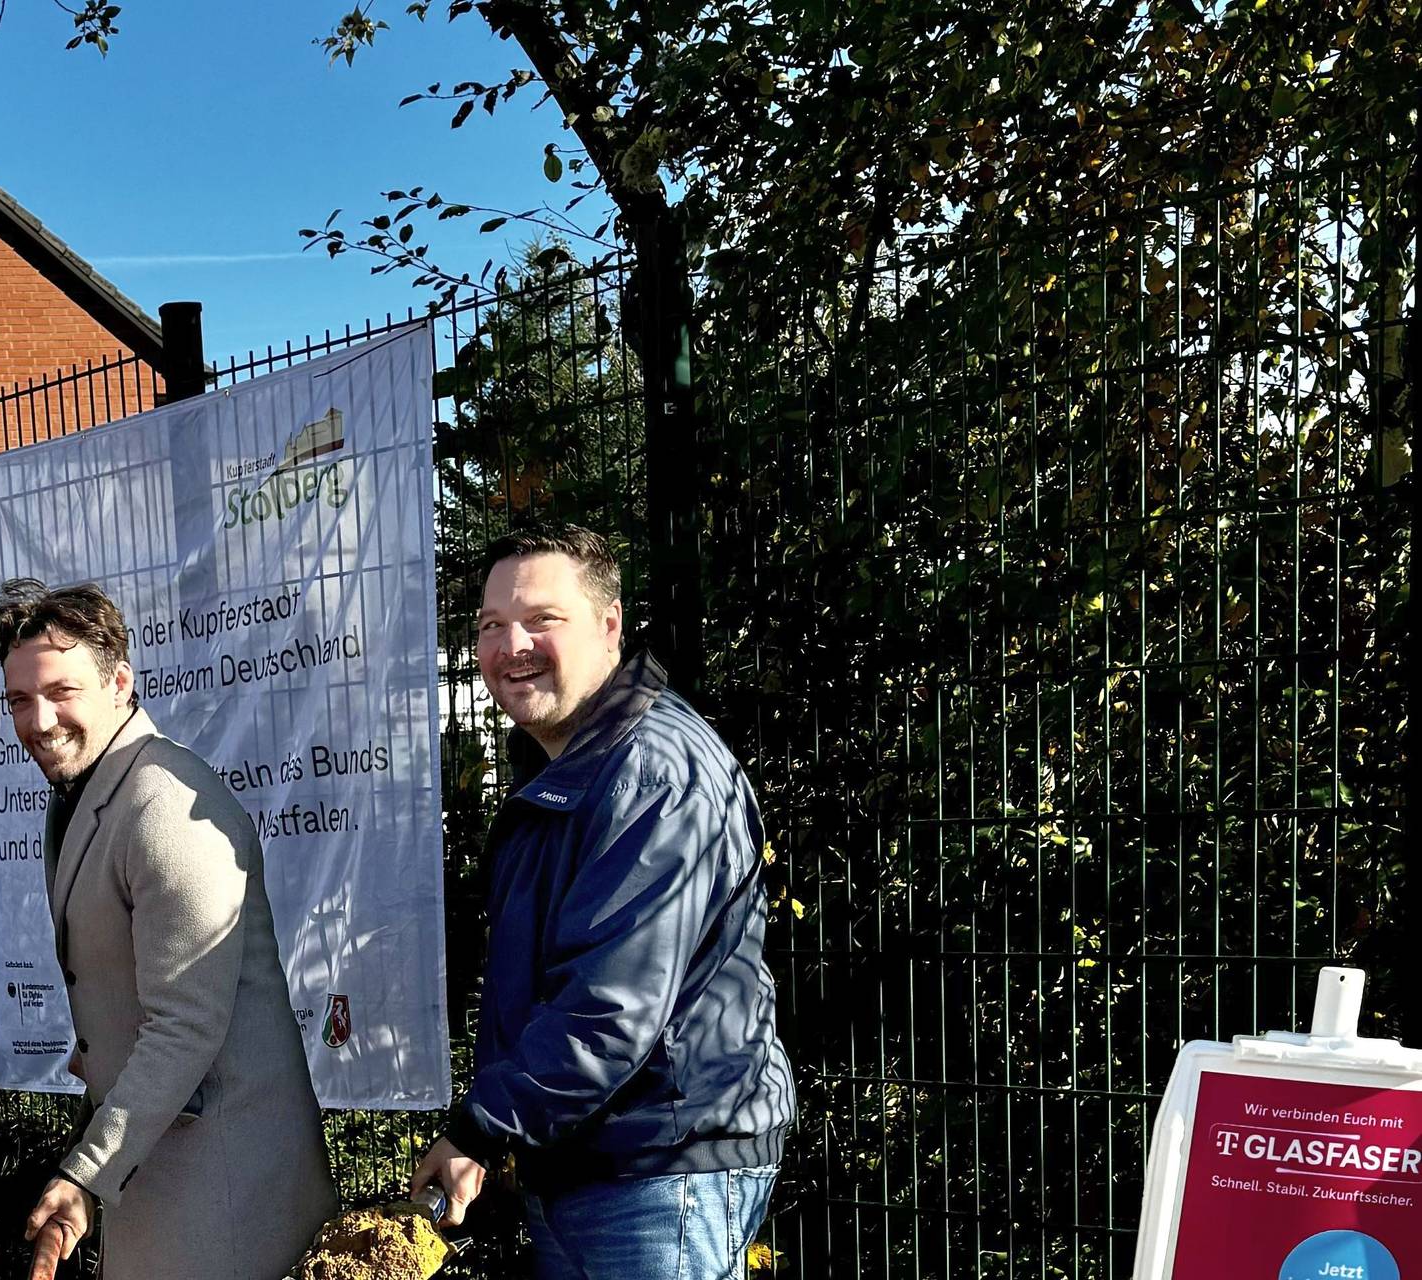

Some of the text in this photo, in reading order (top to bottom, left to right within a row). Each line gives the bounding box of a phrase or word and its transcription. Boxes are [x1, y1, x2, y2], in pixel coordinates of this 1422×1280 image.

[227, 452, 276, 480] Kupferstadt
[224, 462, 349, 529] Stolberg
[143, 616, 174, 648] der
[179, 585, 301, 643] Kupferstadt
[139, 624, 361, 700] Telekom Deutschland
[212, 760, 273, 792] teln
[1244, 1103, 1403, 1129] Wir verbinden Euch mit
[1244, 1134, 1421, 1174] GLASFASER
[1211, 1175, 1414, 1207] Schnell. Stabil. Zukunftssicher.
[1318, 1262, 1364, 1279] Jetzt
